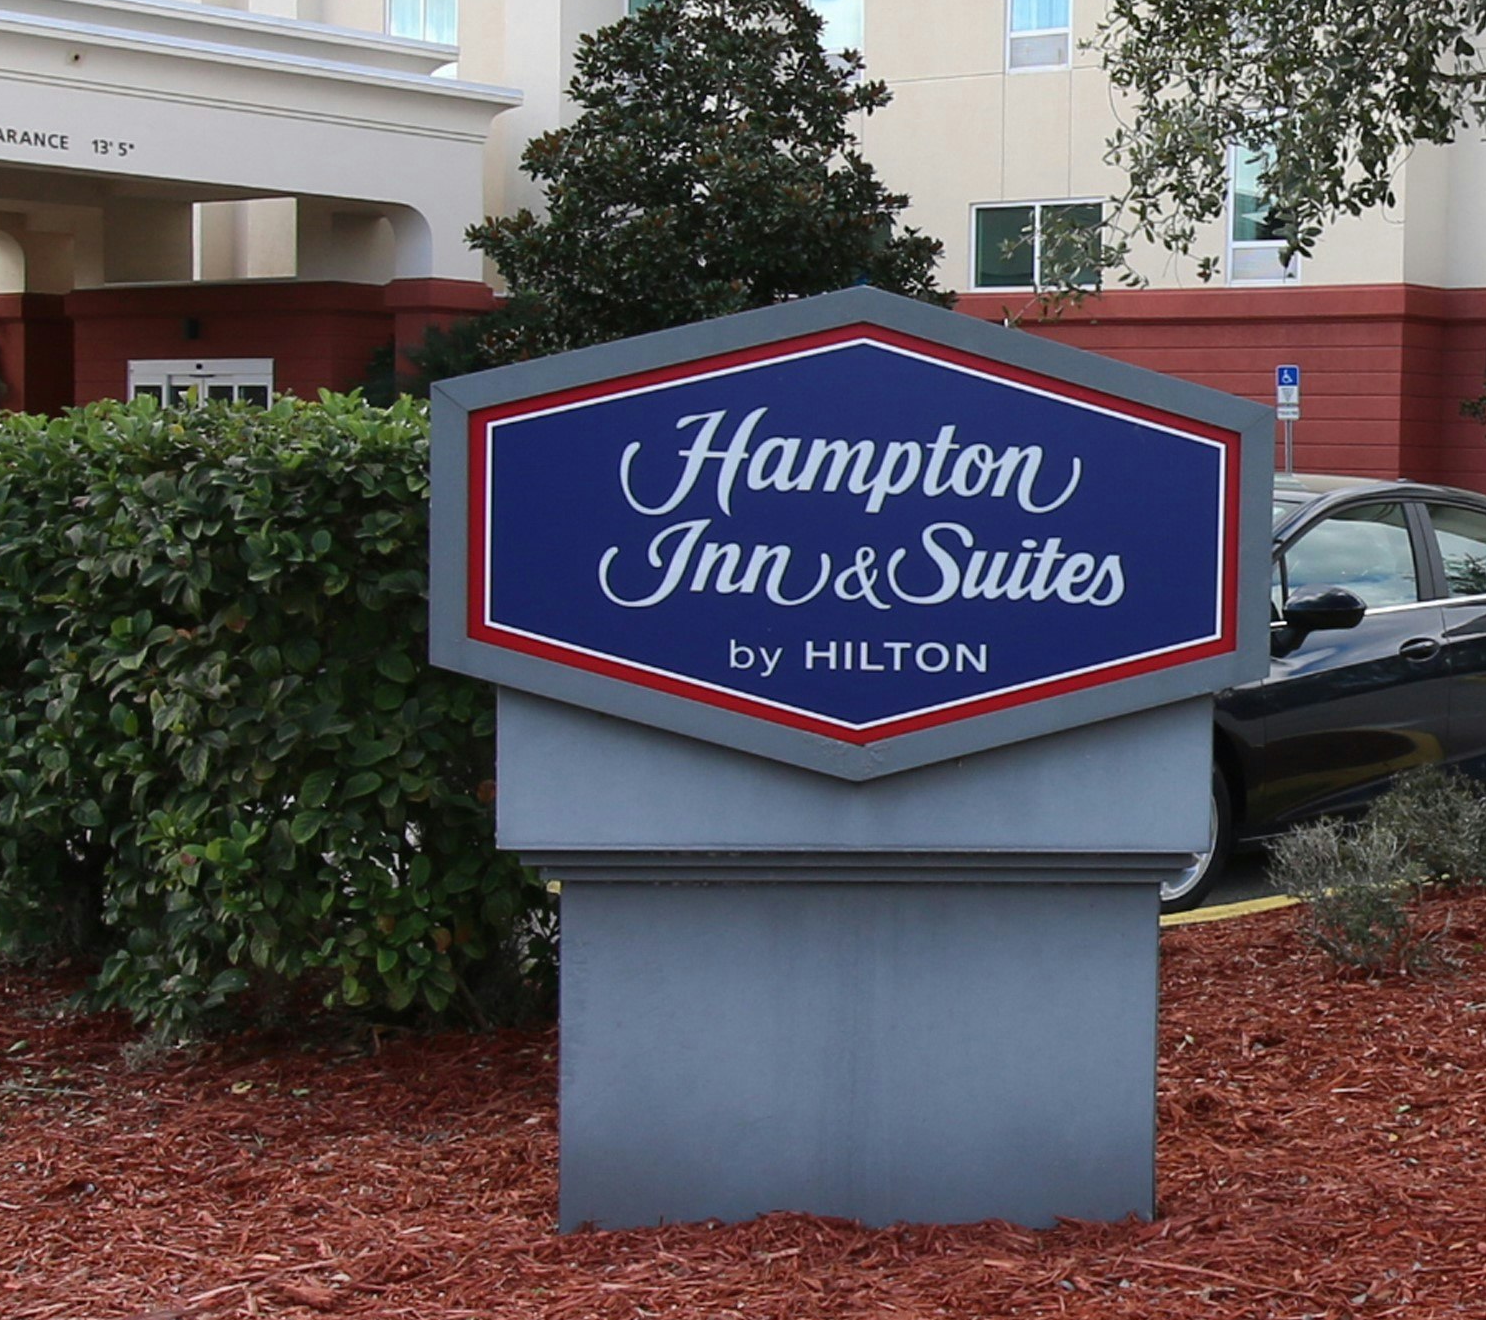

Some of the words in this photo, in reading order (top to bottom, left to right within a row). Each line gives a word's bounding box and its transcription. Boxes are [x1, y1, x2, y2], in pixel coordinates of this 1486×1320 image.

[620, 407, 1081, 516] Hampton
[598, 519, 831, 607] Inn
[834, 546, 891, 610] &
[888, 522, 1125, 607] Suites
[729, 639, 783, 678] by
[804, 640, 989, 673] HILTON
